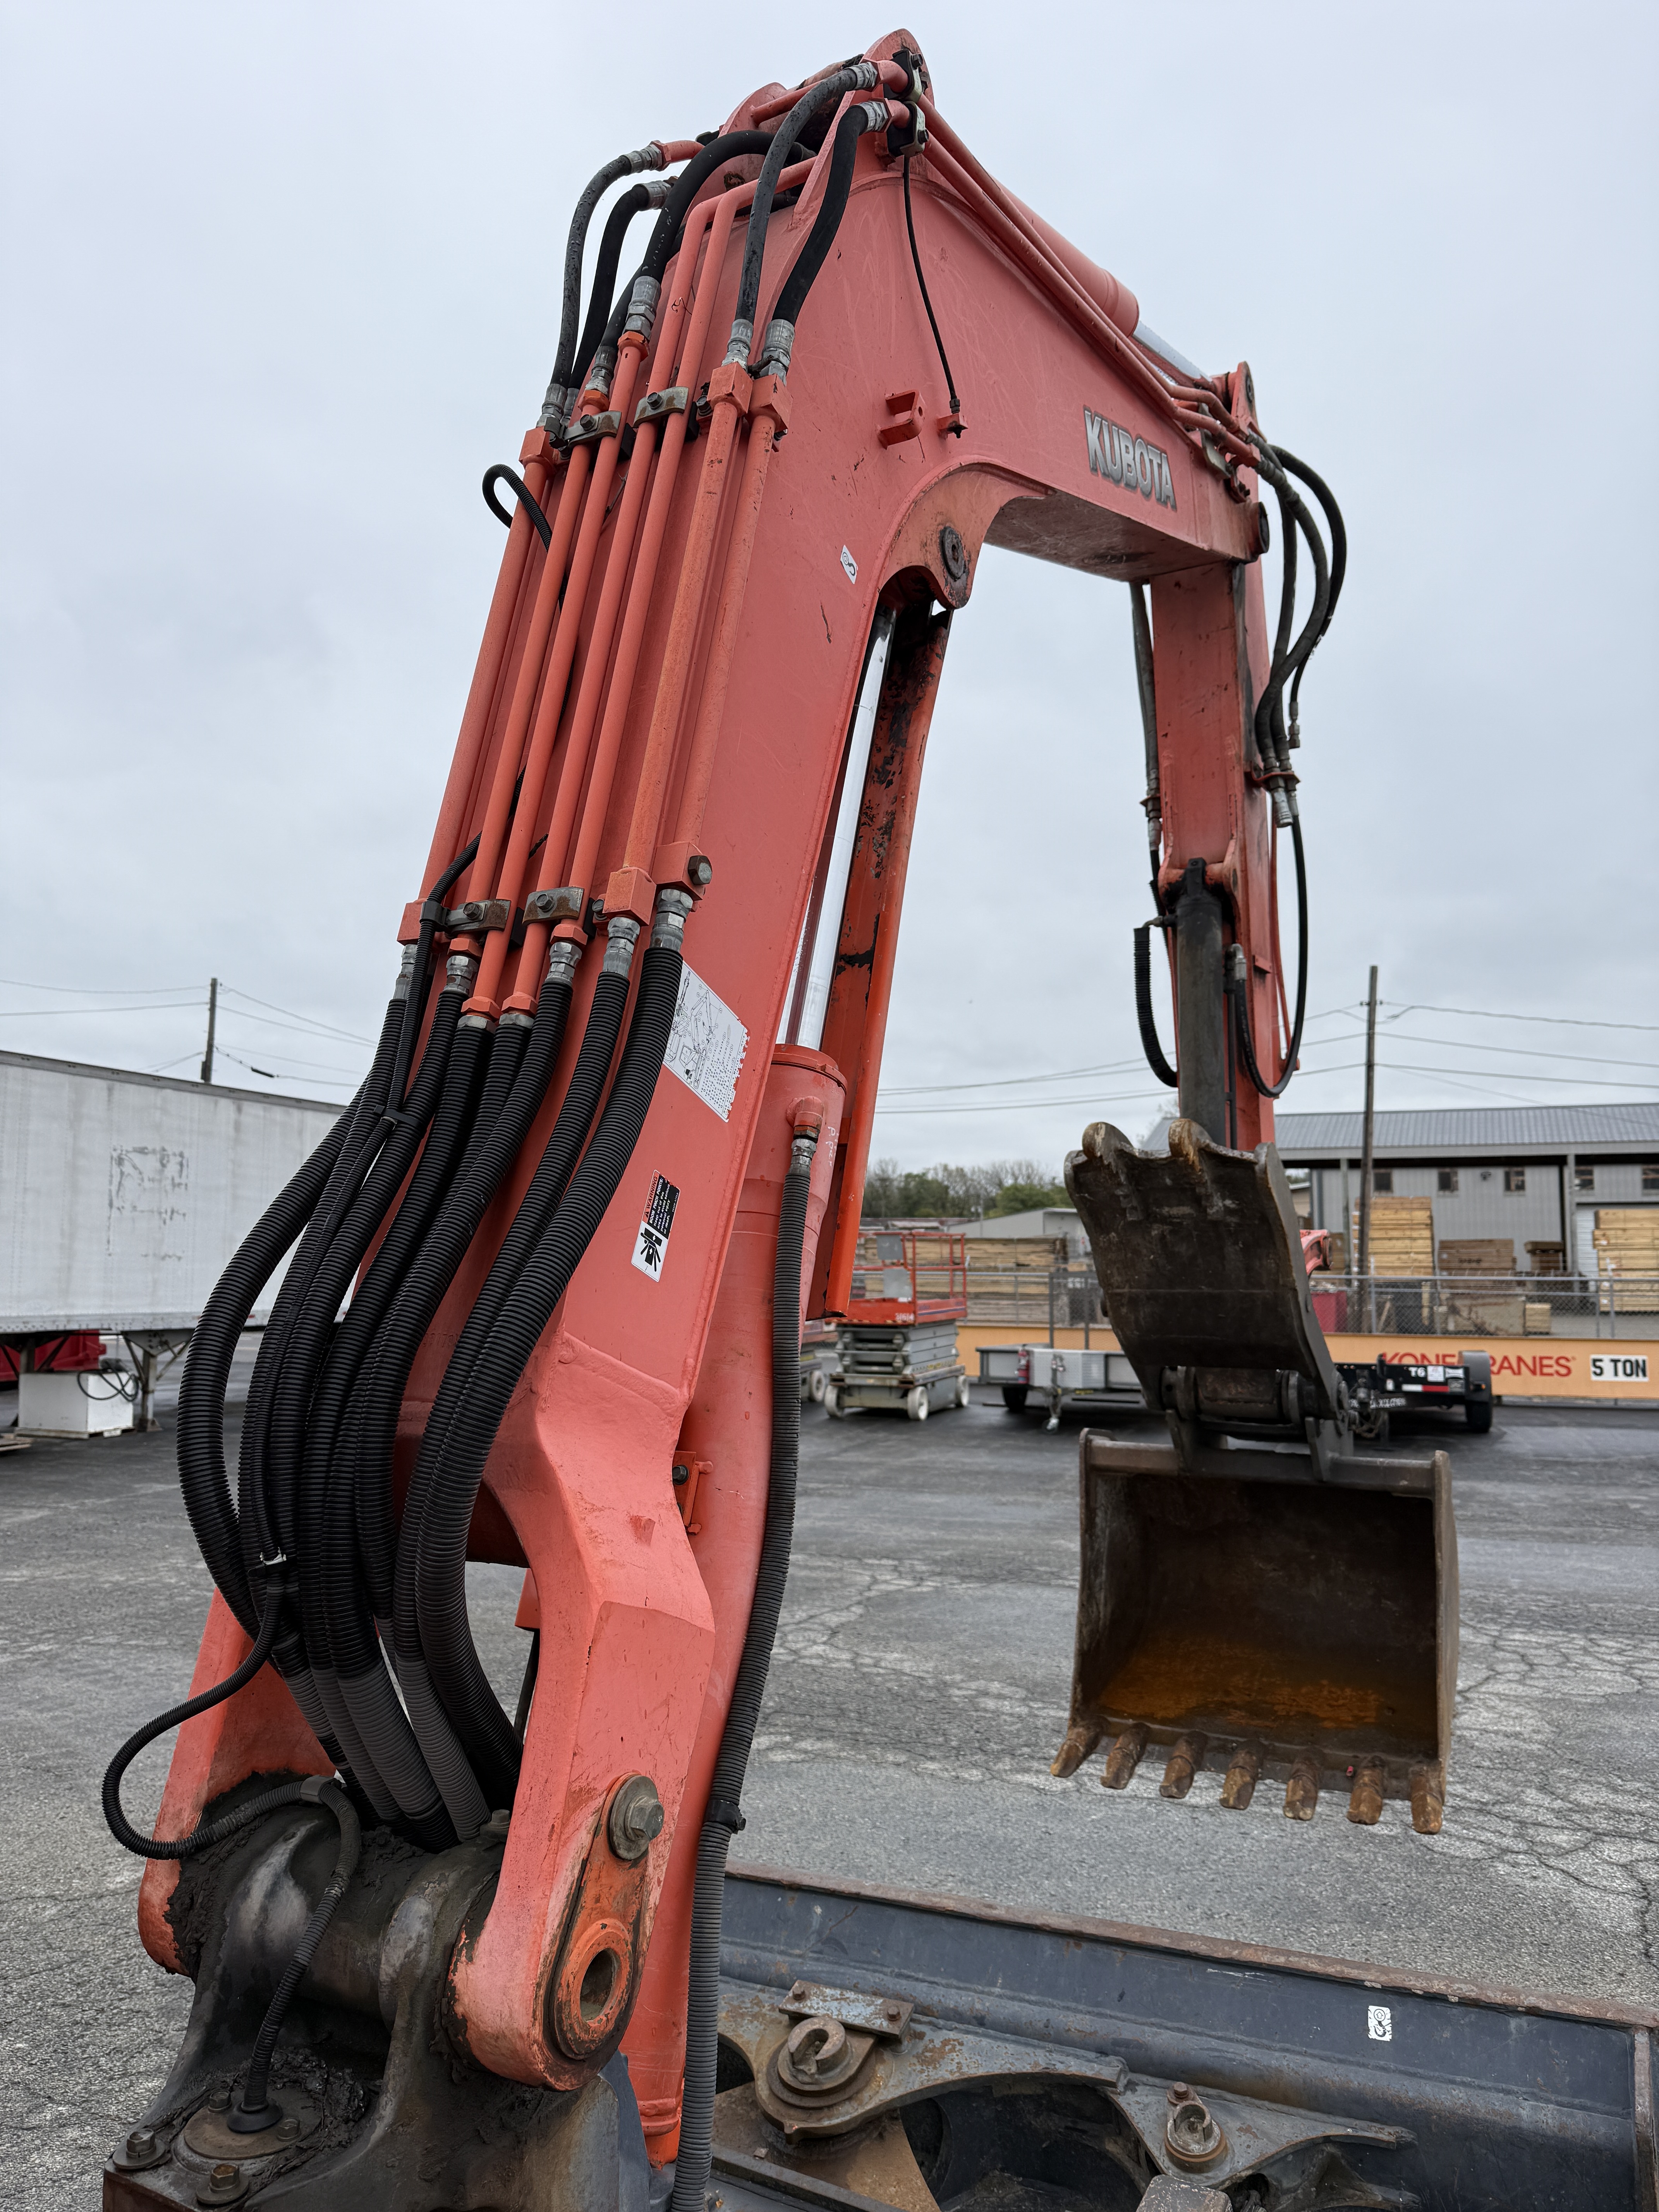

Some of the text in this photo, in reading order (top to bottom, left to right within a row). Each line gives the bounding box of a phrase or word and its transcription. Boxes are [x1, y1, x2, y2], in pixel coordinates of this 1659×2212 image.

[1083, 405, 1177, 512] KUBOTA
[646, 1176, 658, 1209] WARNING
[1382, 1352, 1572, 1377] KONERANES
[1408, 1367, 1426, 1377] T6
[1592, 1358, 1647, 1377] 5 TON
